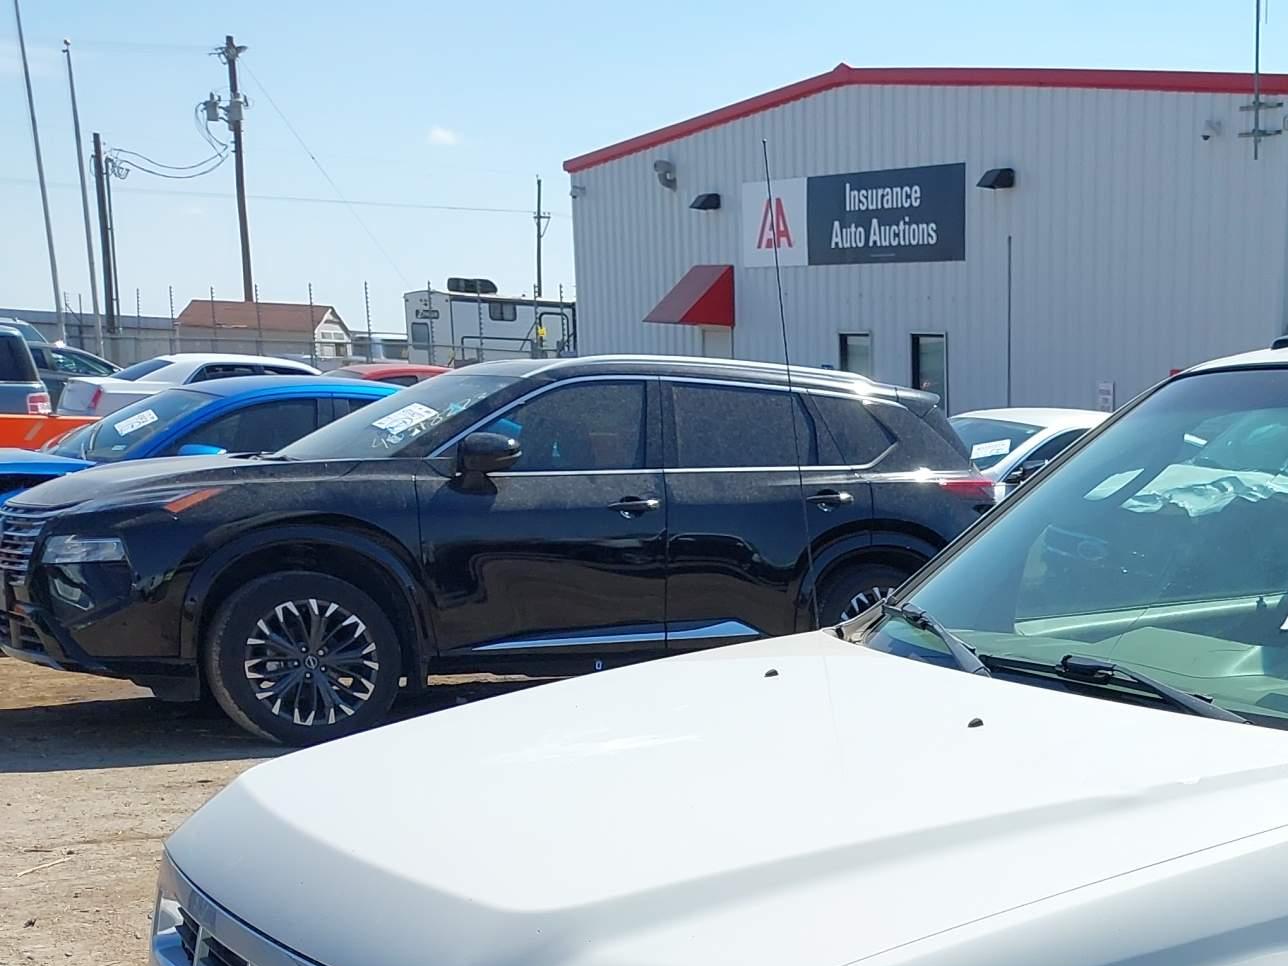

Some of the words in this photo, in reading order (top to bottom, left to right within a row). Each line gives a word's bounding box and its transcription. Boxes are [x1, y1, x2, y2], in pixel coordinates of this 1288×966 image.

[845, 183, 921, 212] Insurance
[831, 220, 865, 249] Auto
[869, 216, 938, 248] Auctions
